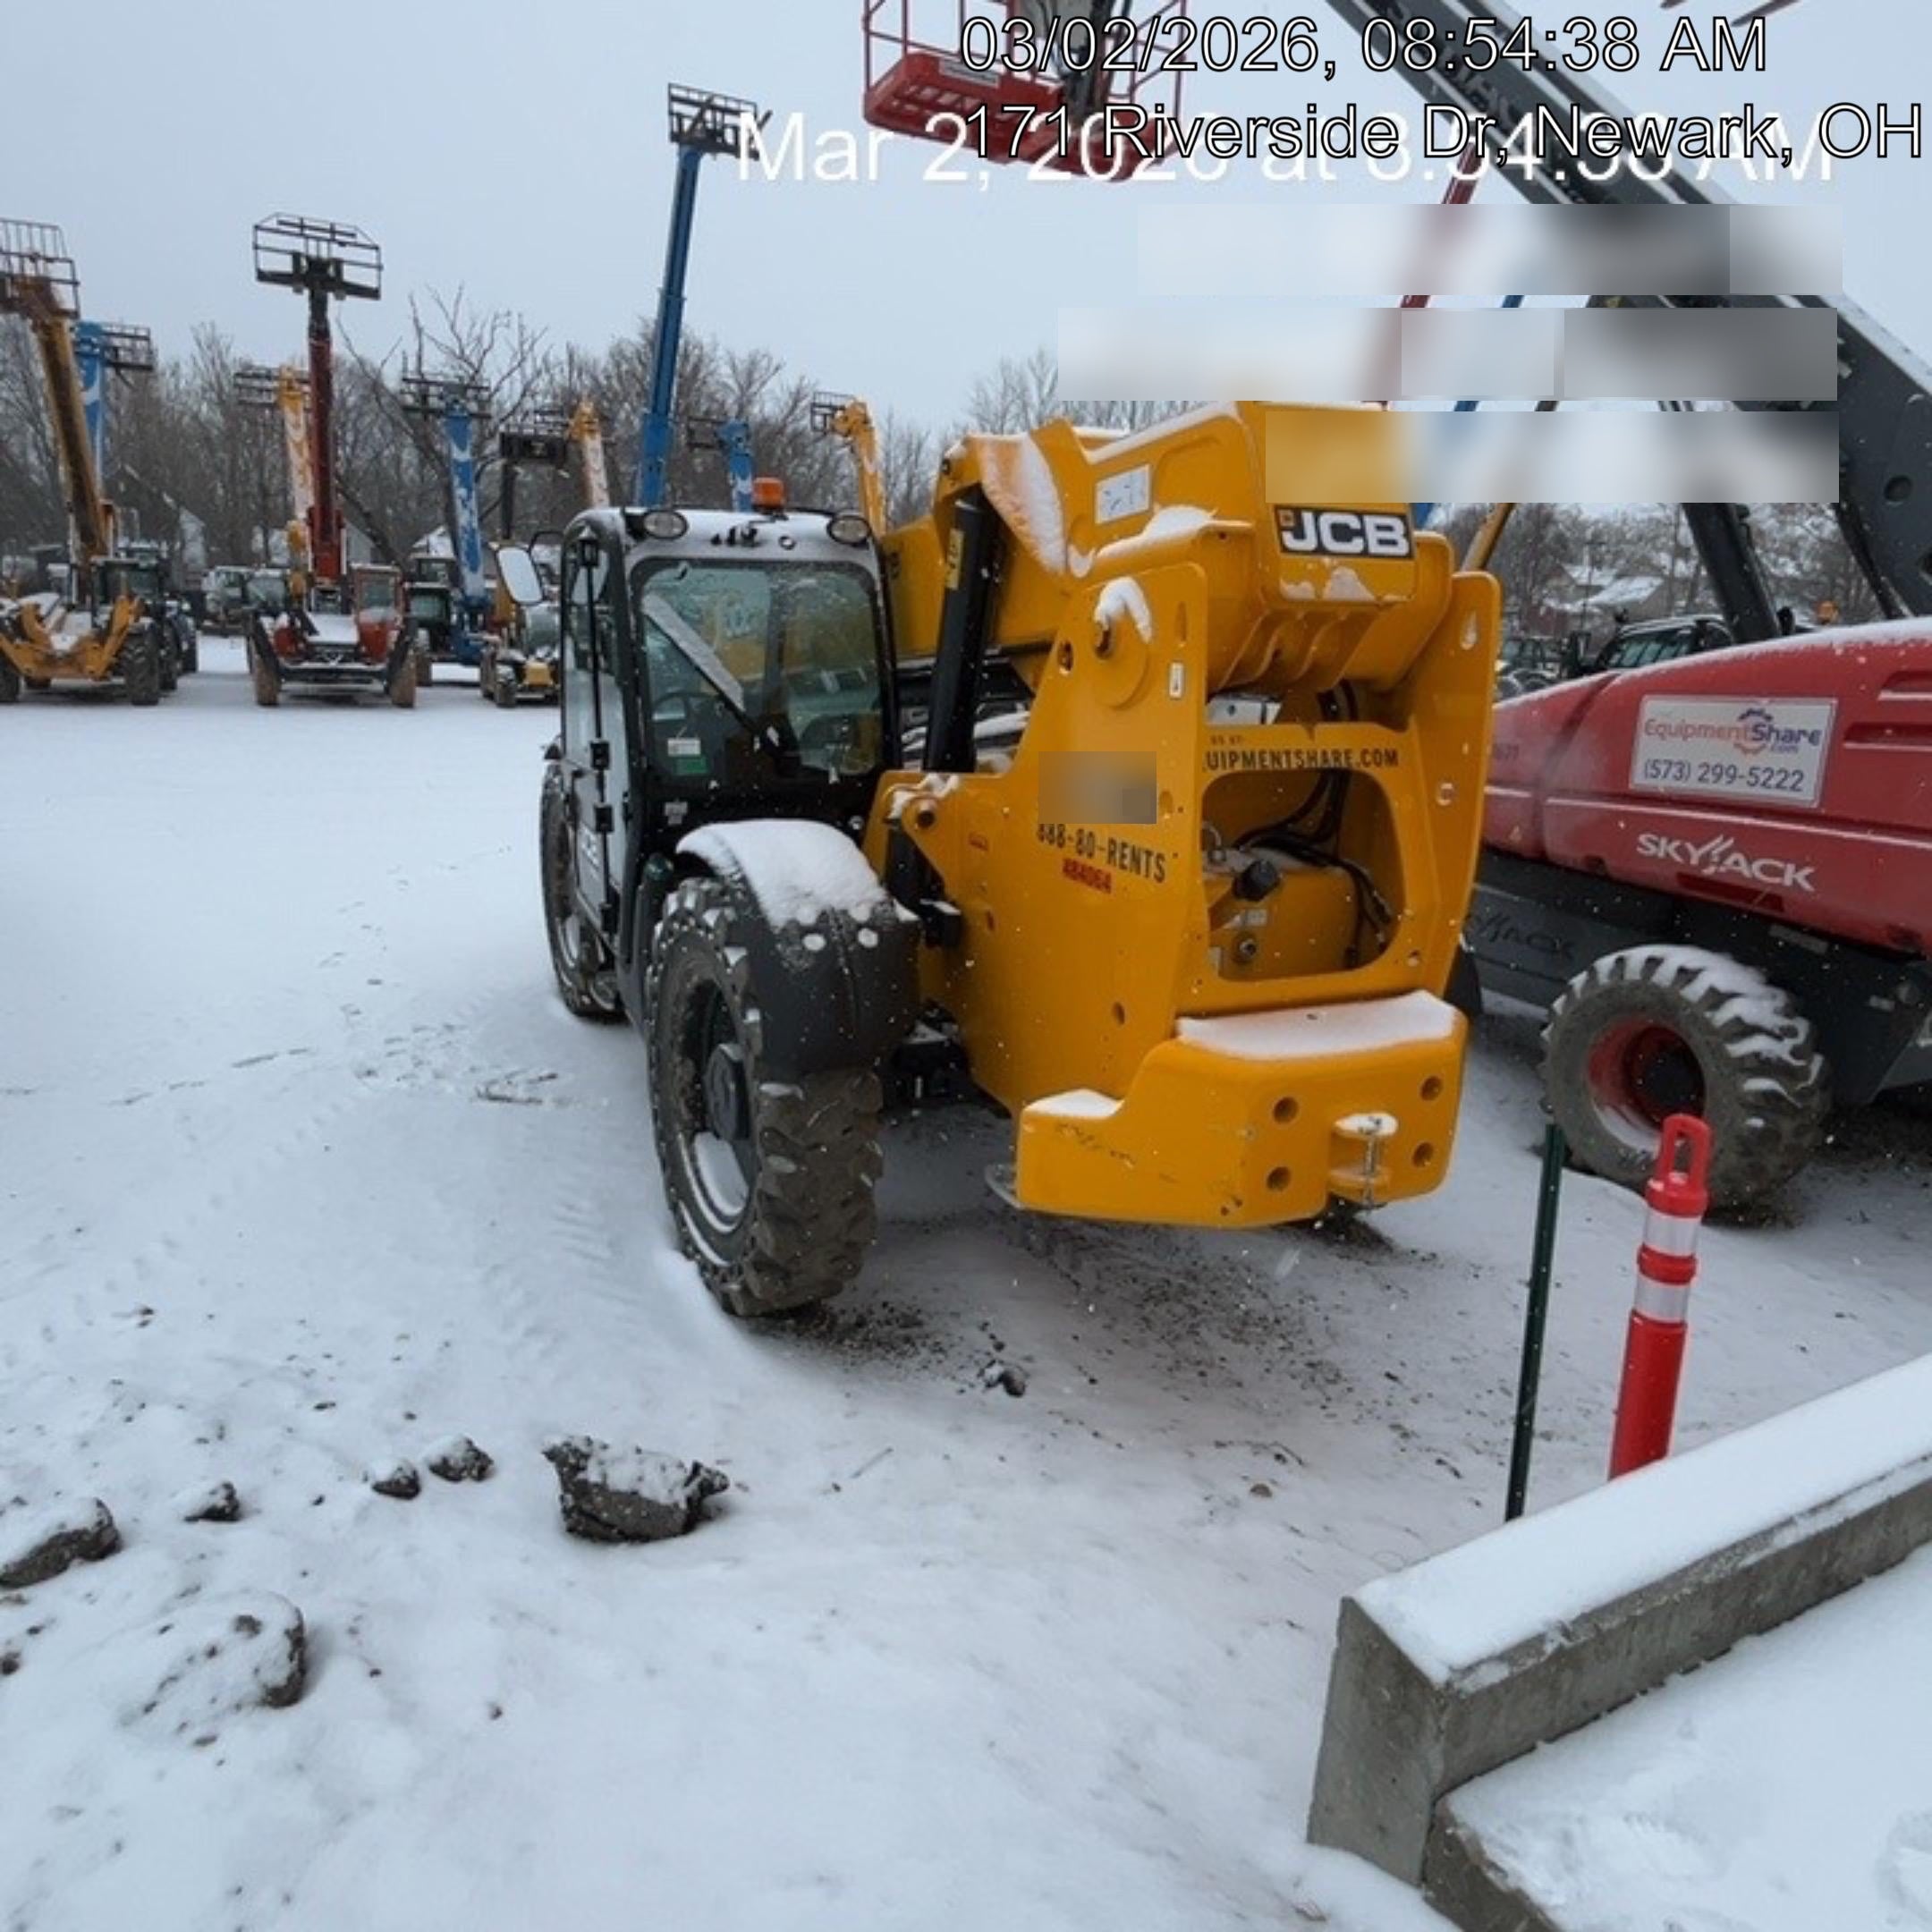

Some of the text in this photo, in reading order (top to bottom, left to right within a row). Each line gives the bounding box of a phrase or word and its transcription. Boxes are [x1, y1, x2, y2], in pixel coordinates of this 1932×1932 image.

[1282, 511, 1410, 556] JCB
[1644, 717, 1823, 746] EquipmentShare
[1643, 758, 1805, 792] (573) 299-5222
[1636, 833, 1816, 893] SKYJACK
